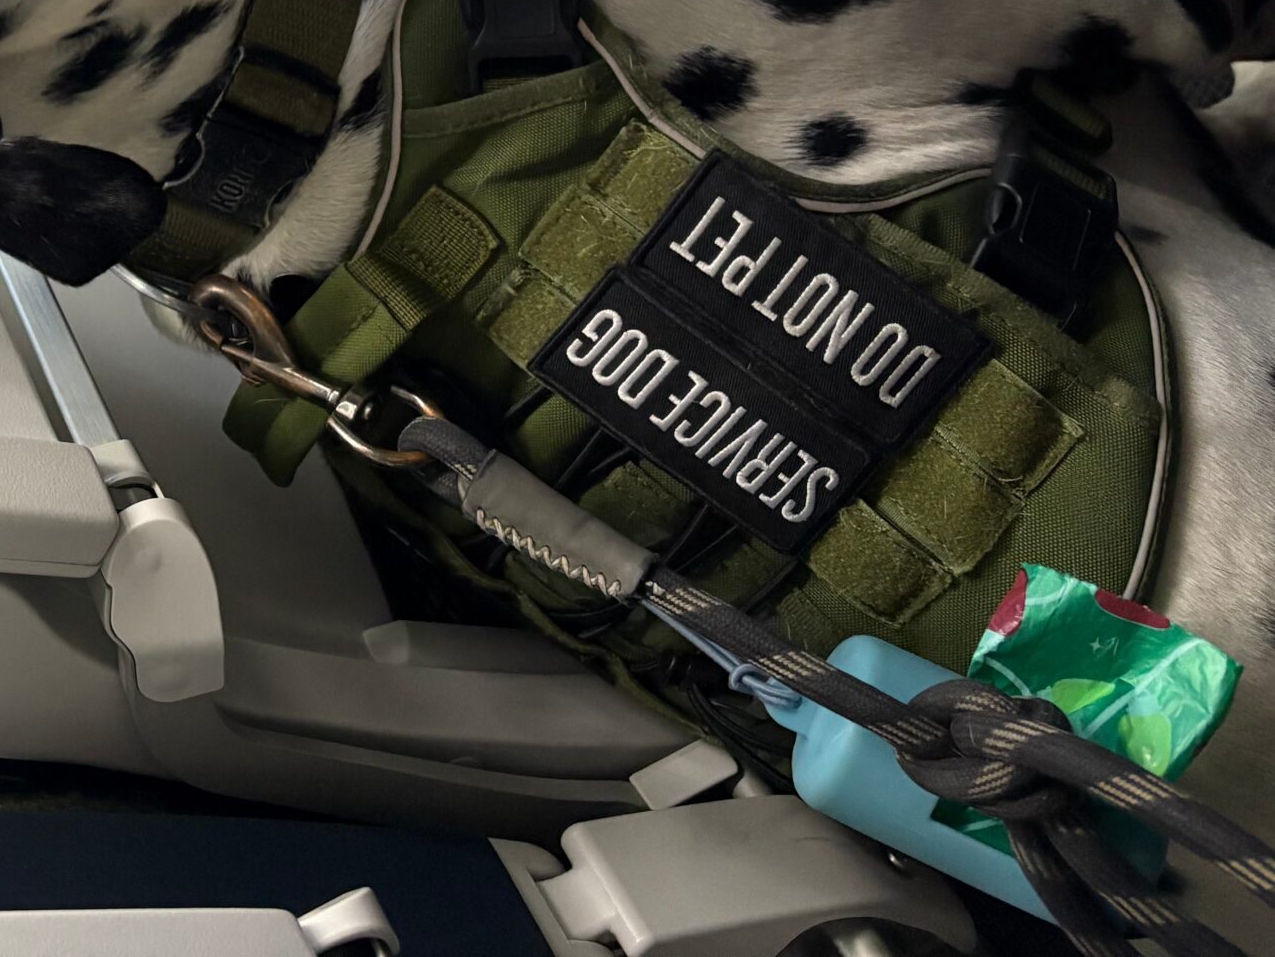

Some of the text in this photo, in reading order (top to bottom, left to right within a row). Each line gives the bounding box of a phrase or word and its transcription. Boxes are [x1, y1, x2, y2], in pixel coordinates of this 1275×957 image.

[209, 161, 255, 214] KON
[669, 196, 942, 409] DO NOT PET
[566, 309, 840, 523] SERVICE DOG
